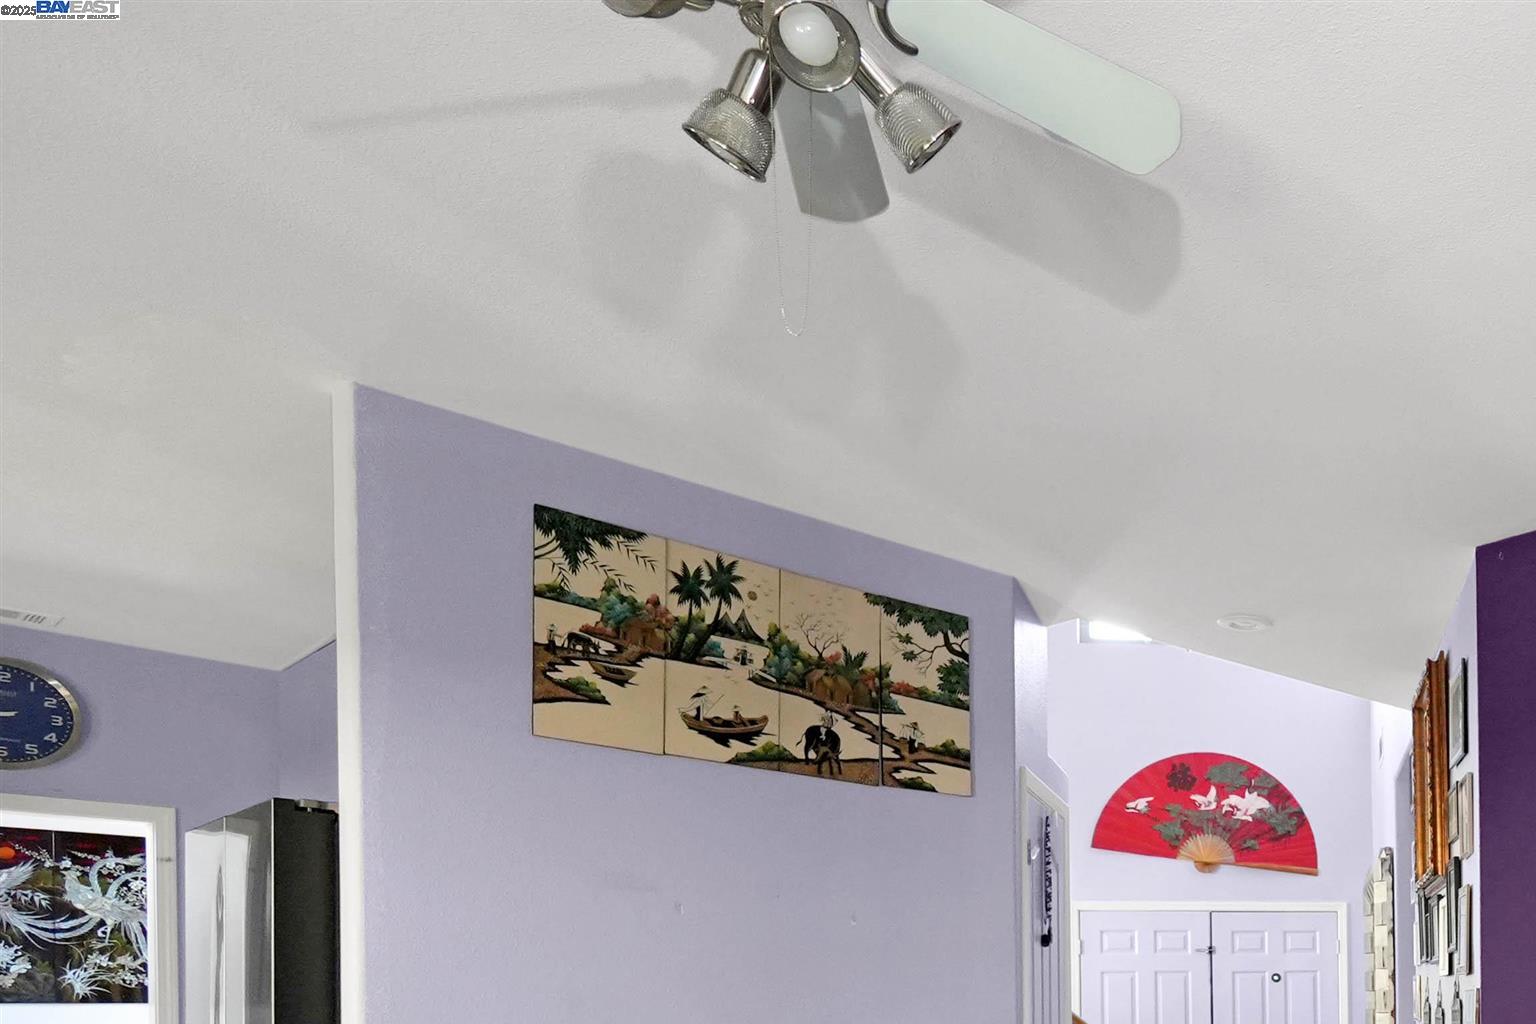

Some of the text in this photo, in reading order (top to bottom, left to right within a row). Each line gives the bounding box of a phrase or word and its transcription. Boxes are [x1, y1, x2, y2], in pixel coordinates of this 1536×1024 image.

[30, 681, 34, 692] 1
[44, 697, 57, 708] 2
[50, 715, 63, 726] 3
[43, 732, 57, 743] 4
[25, 743, 39, 755] 5
